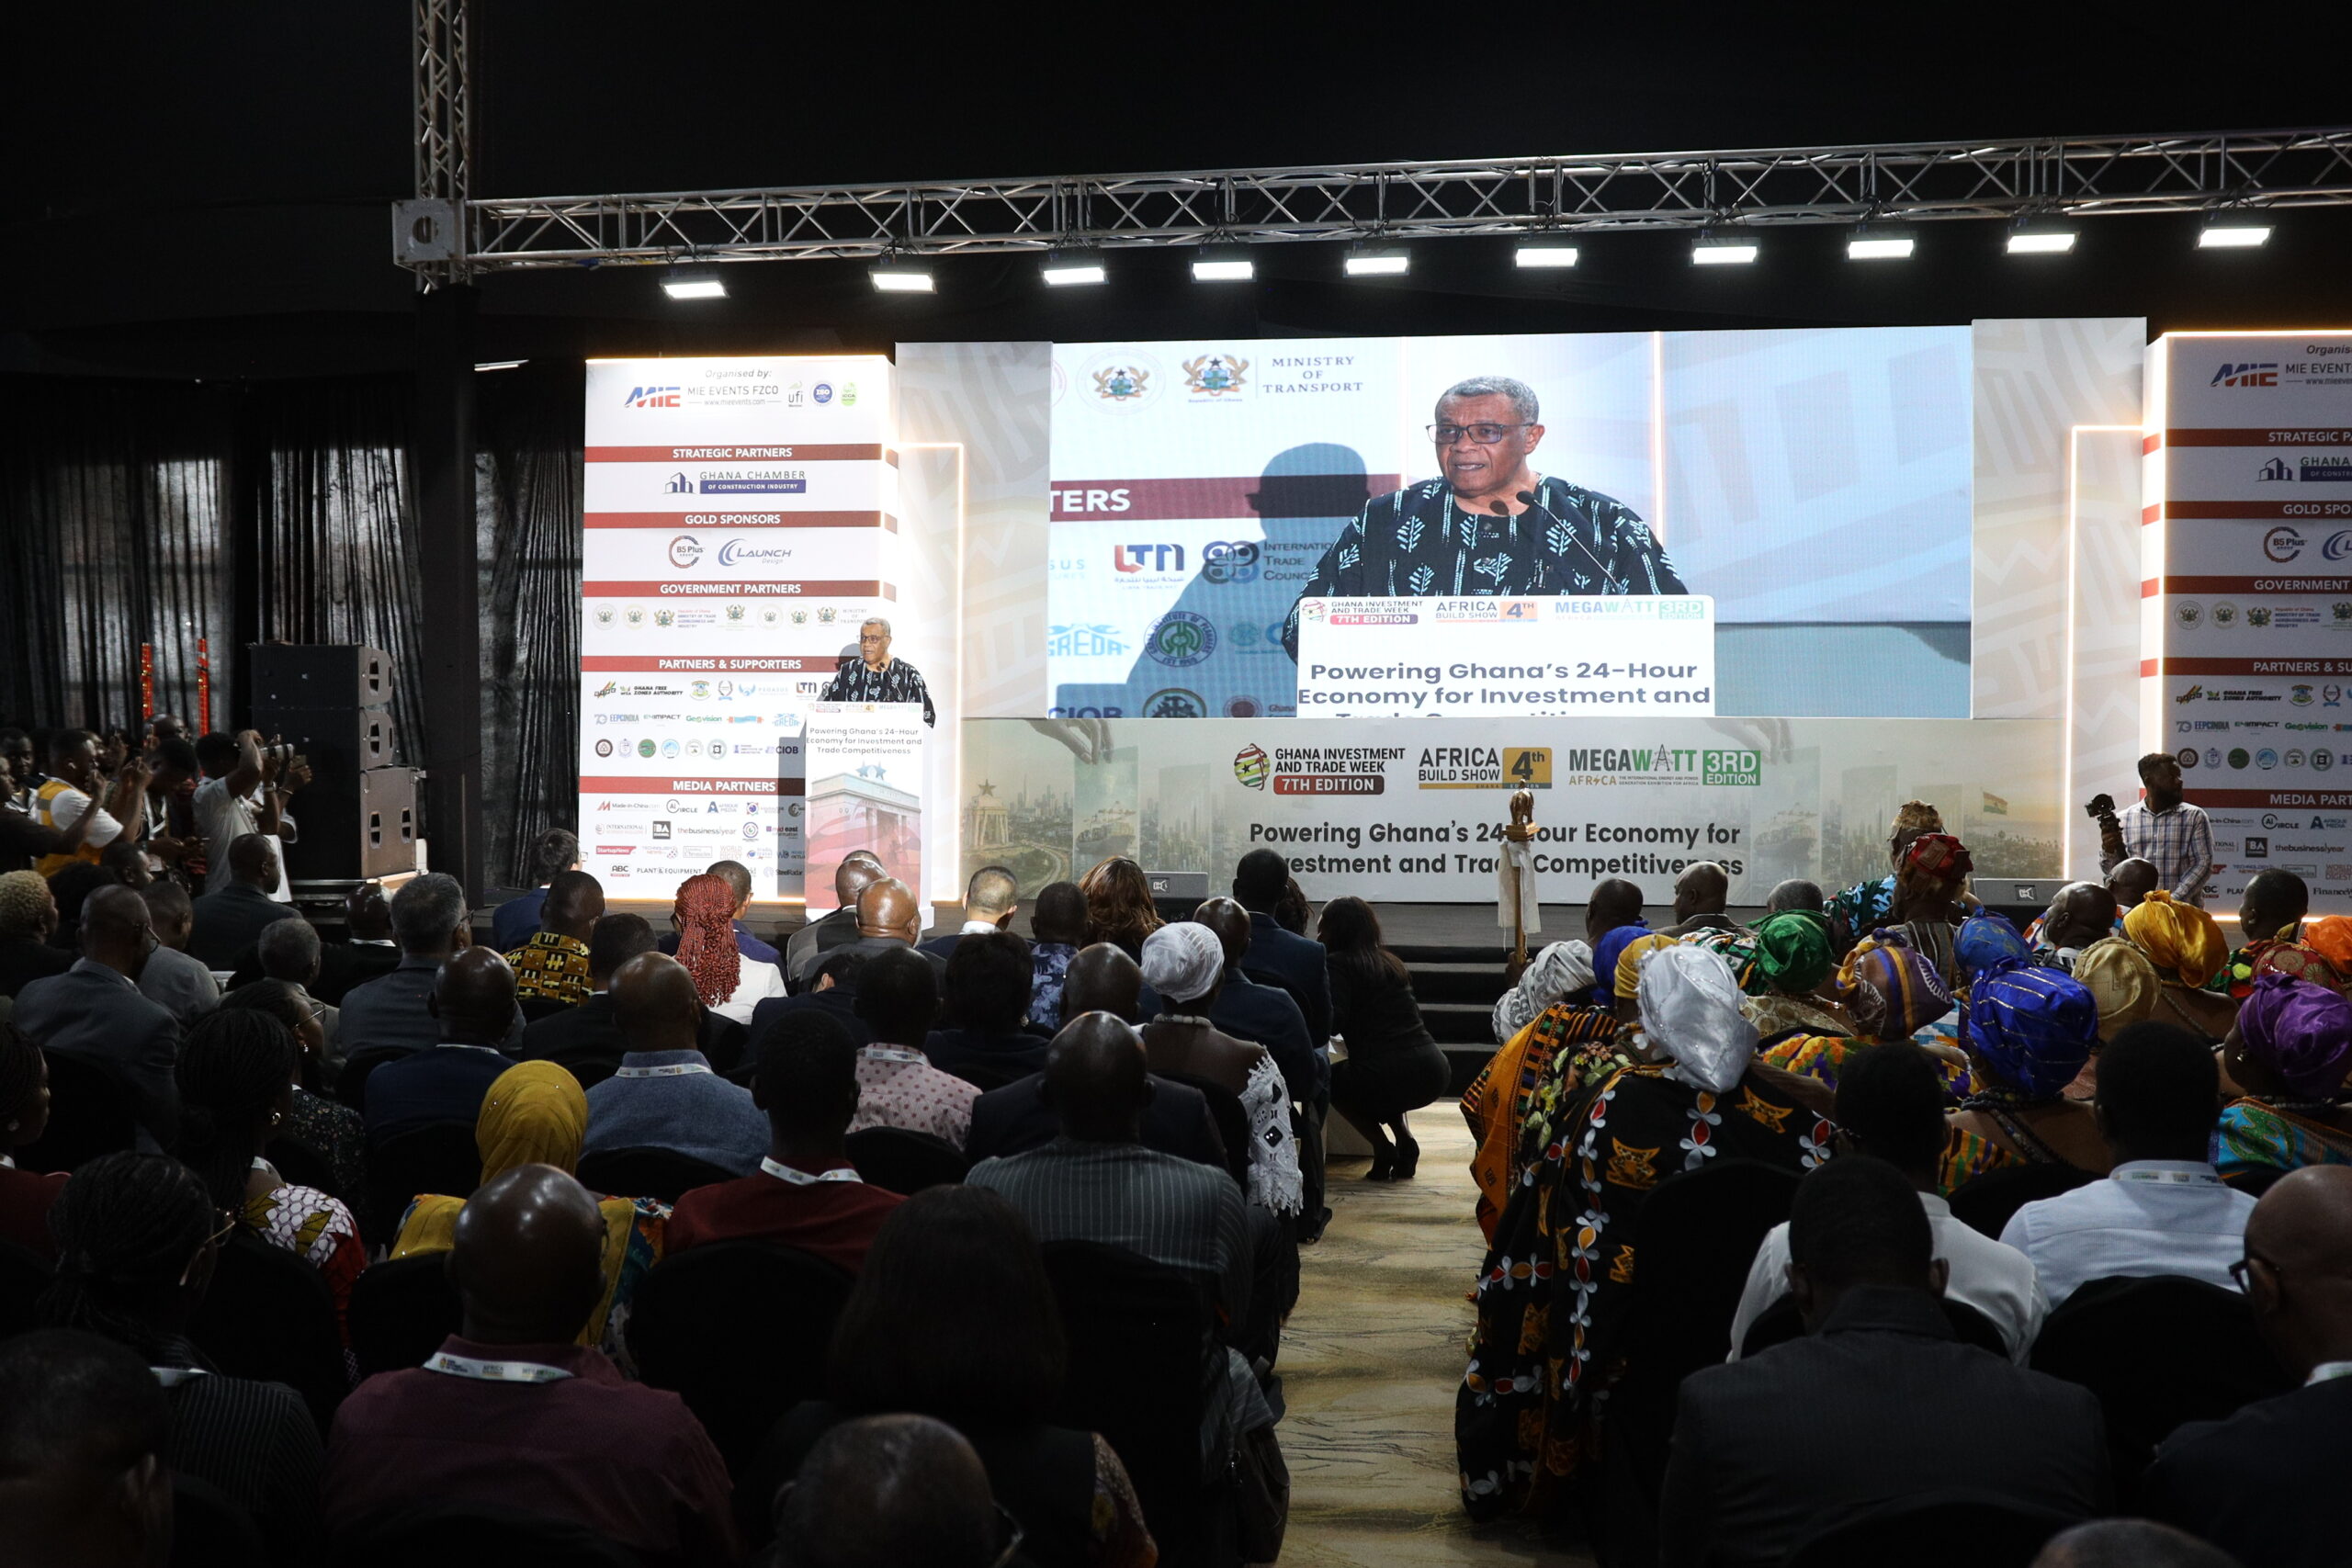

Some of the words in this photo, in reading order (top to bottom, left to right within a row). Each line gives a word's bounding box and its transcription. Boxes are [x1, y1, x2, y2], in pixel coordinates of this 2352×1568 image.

[2306, 344, 2352, 356] Organis
[1272, 355, 1355, 367] MINISTRY
[705, 369, 754, 379] Organised
[757, 368, 773, 379] by:
[2285, 363, 2307, 374] MIE
[2311, 363, 2352, 374] EVENT
[1303, 370, 1323, 379] OF
[2211, 363, 2278, 388] MIE
[687, 386, 706, 396] MIE
[708, 386, 750, 396] EVENTS
[752, 385, 779, 395] FZCO
[1262, 381, 1363, 393] TRANSPORT
[625, 387, 681, 408] MIE
[788, 390, 804, 403] ufi
[2267, 431, 2339, 442] STRATEGIC
[673, 448, 732, 458] STRATEGIC
[735, 447, 793, 457] PARTNERS
[2300, 457, 2350, 467] GHANA
[700, 470, 742, 479] GHANA
[747, 470, 806, 479] CHAMBER
[2283, 504, 2321, 514] GOLD
[685, 515, 718, 525] GOLD
[720, 514, 781, 525] SPONSORS
[1263, 541, 1334, 551] INTERNATIO
[2286, 537, 2305, 546] Plus
[736, 547, 792, 558] LAUNCH
[1263, 556, 1306, 566] TRADE
[1263, 570, 1310, 581] COUNC
[661, 584, 741, 594] GOVERNMENT
[744, 583, 802, 593] PARTNERS
[2254, 580, 2350, 591] GOVERNMENT
[1436, 601, 1498, 612] AFRICA
[1661, 601, 1702, 614] 3RD
[1363, 615, 1411, 623] EDITION
[659, 659, 716, 669] PARTNERS
[718, 660, 728, 670] &
[729, 660, 802, 670] SUPPORTERS
[2253, 661, 2320, 672] PARTNERS
[2324, 661, 2334, 672] &
[1311, 662, 1442, 684] Powering
[1576, 662, 1698, 679] 24-Hour
[1298, 689, 1428, 709] Economy
[1435, 687, 1474, 704] for
[1481, 687, 1646, 704] Investment
[1654, 687, 1711, 704] and
[2285, 721, 2328, 731] Geovision
[809, 728, 847, 736] Powering
[885, 728, 919, 736] 24-Hour
[775, 745, 799, 754] CIOB
[842, 747, 911, 755] Competitiveness
[1275, 748, 1321, 760] GHANA
[1324, 748, 1406, 760] INVESTMENT
[1419, 747, 1499, 767] AFRICA
[1569, 744, 1697, 772] MEGAWATT
[1706, 751, 1758, 773] 3RD
[1275, 761, 1302, 773] AND
[1305, 761, 1346, 773] TRADE
[1350, 761, 1385, 773] WEEK
[1419, 769, 1457, 781] BUILD
[1461, 769, 1500, 781] SHOW
[1706, 773, 1757, 785] EDITION
[673, 781, 713, 791] MEDIA
[715, 781, 776, 792] PARTNERS
[1282, 778, 1310, 791] 7TH
[1315, 778, 1374, 791] EDITION
[2269, 794, 2316, 805] MEDIA
[1250, 821, 1361, 849] Powering
[1476, 823, 1577, 843] 24our
[1585, 823, 1700, 850] Economy
[1707, 822, 1741, 843] for
[1285, 853, 1392, 874] estment
[1398, 853, 1447, 874] and
[1454, 853, 1501, 874] Tra
[1532, 853, 1744, 879] Competitivess
